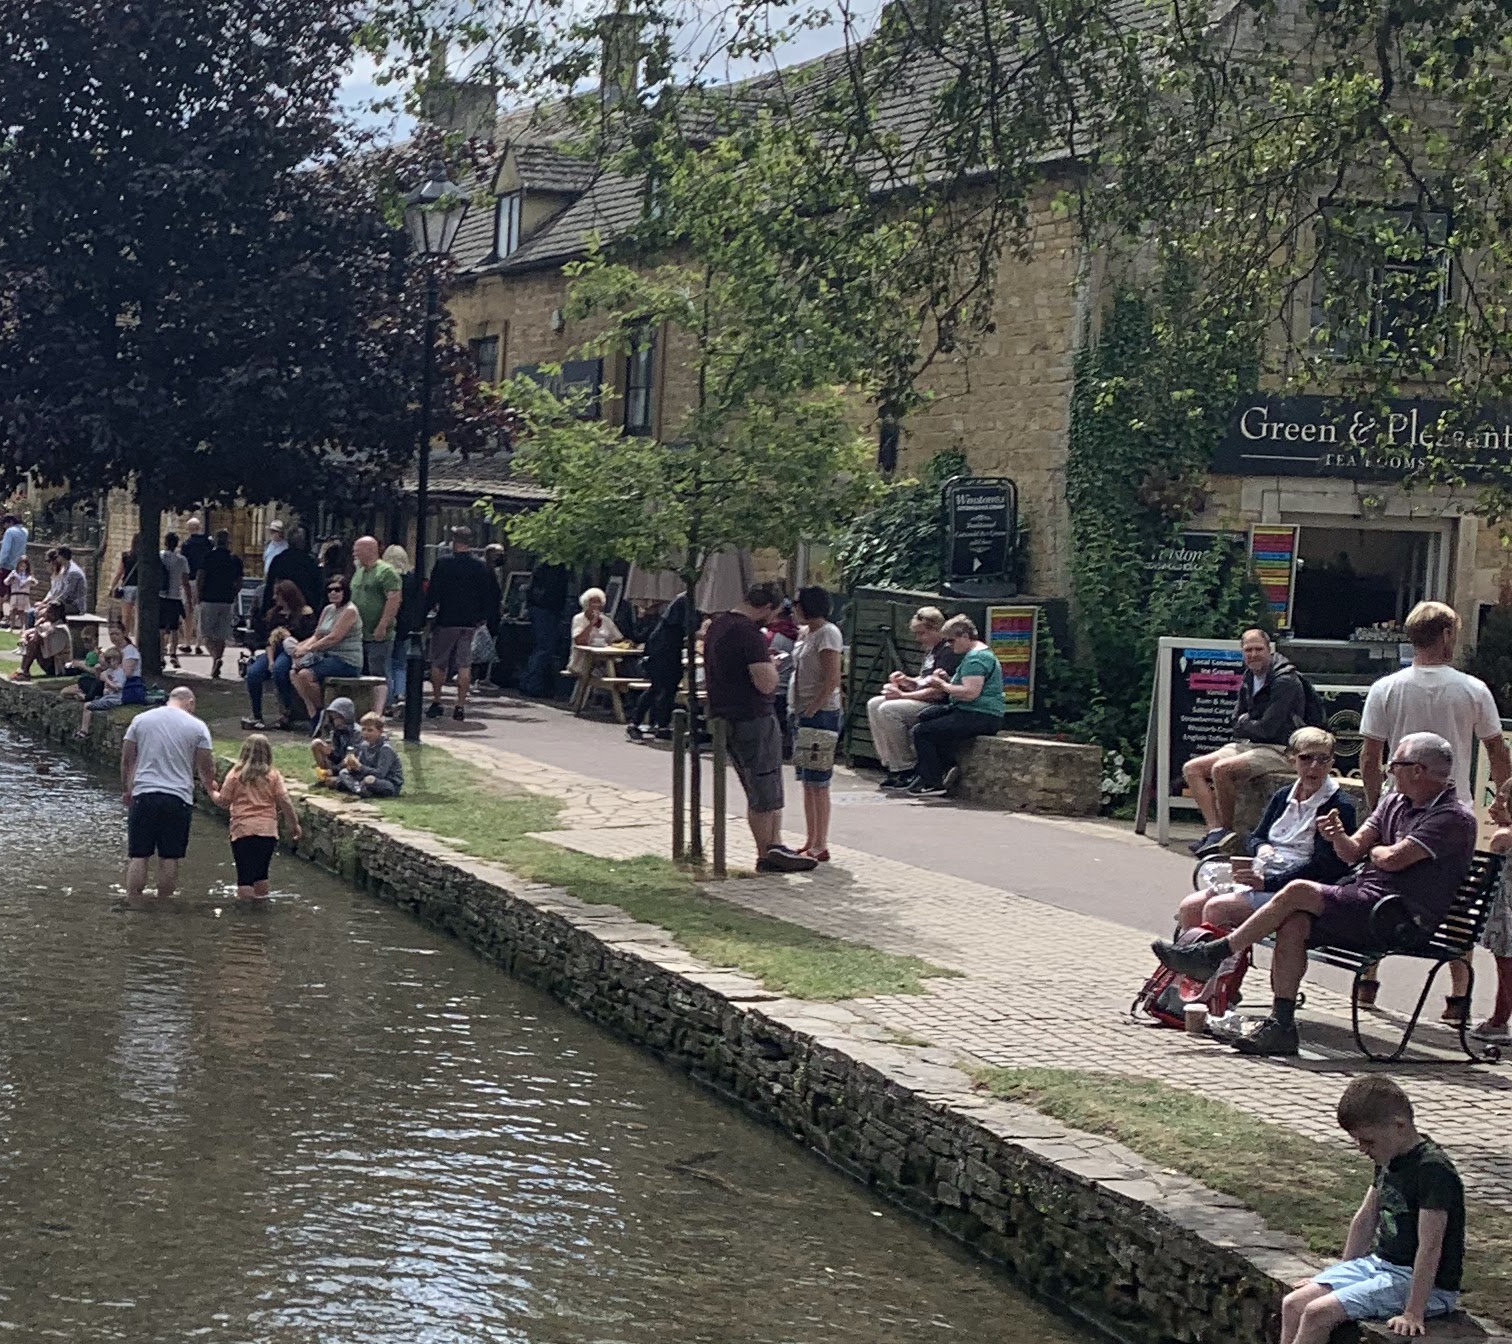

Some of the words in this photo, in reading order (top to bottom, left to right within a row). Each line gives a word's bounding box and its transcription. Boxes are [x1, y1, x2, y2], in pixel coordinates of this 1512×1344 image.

[1240, 406, 1337, 443] Green
[1348, 411, 1376, 444] &
[1324, 453, 1356, 467] TEA
